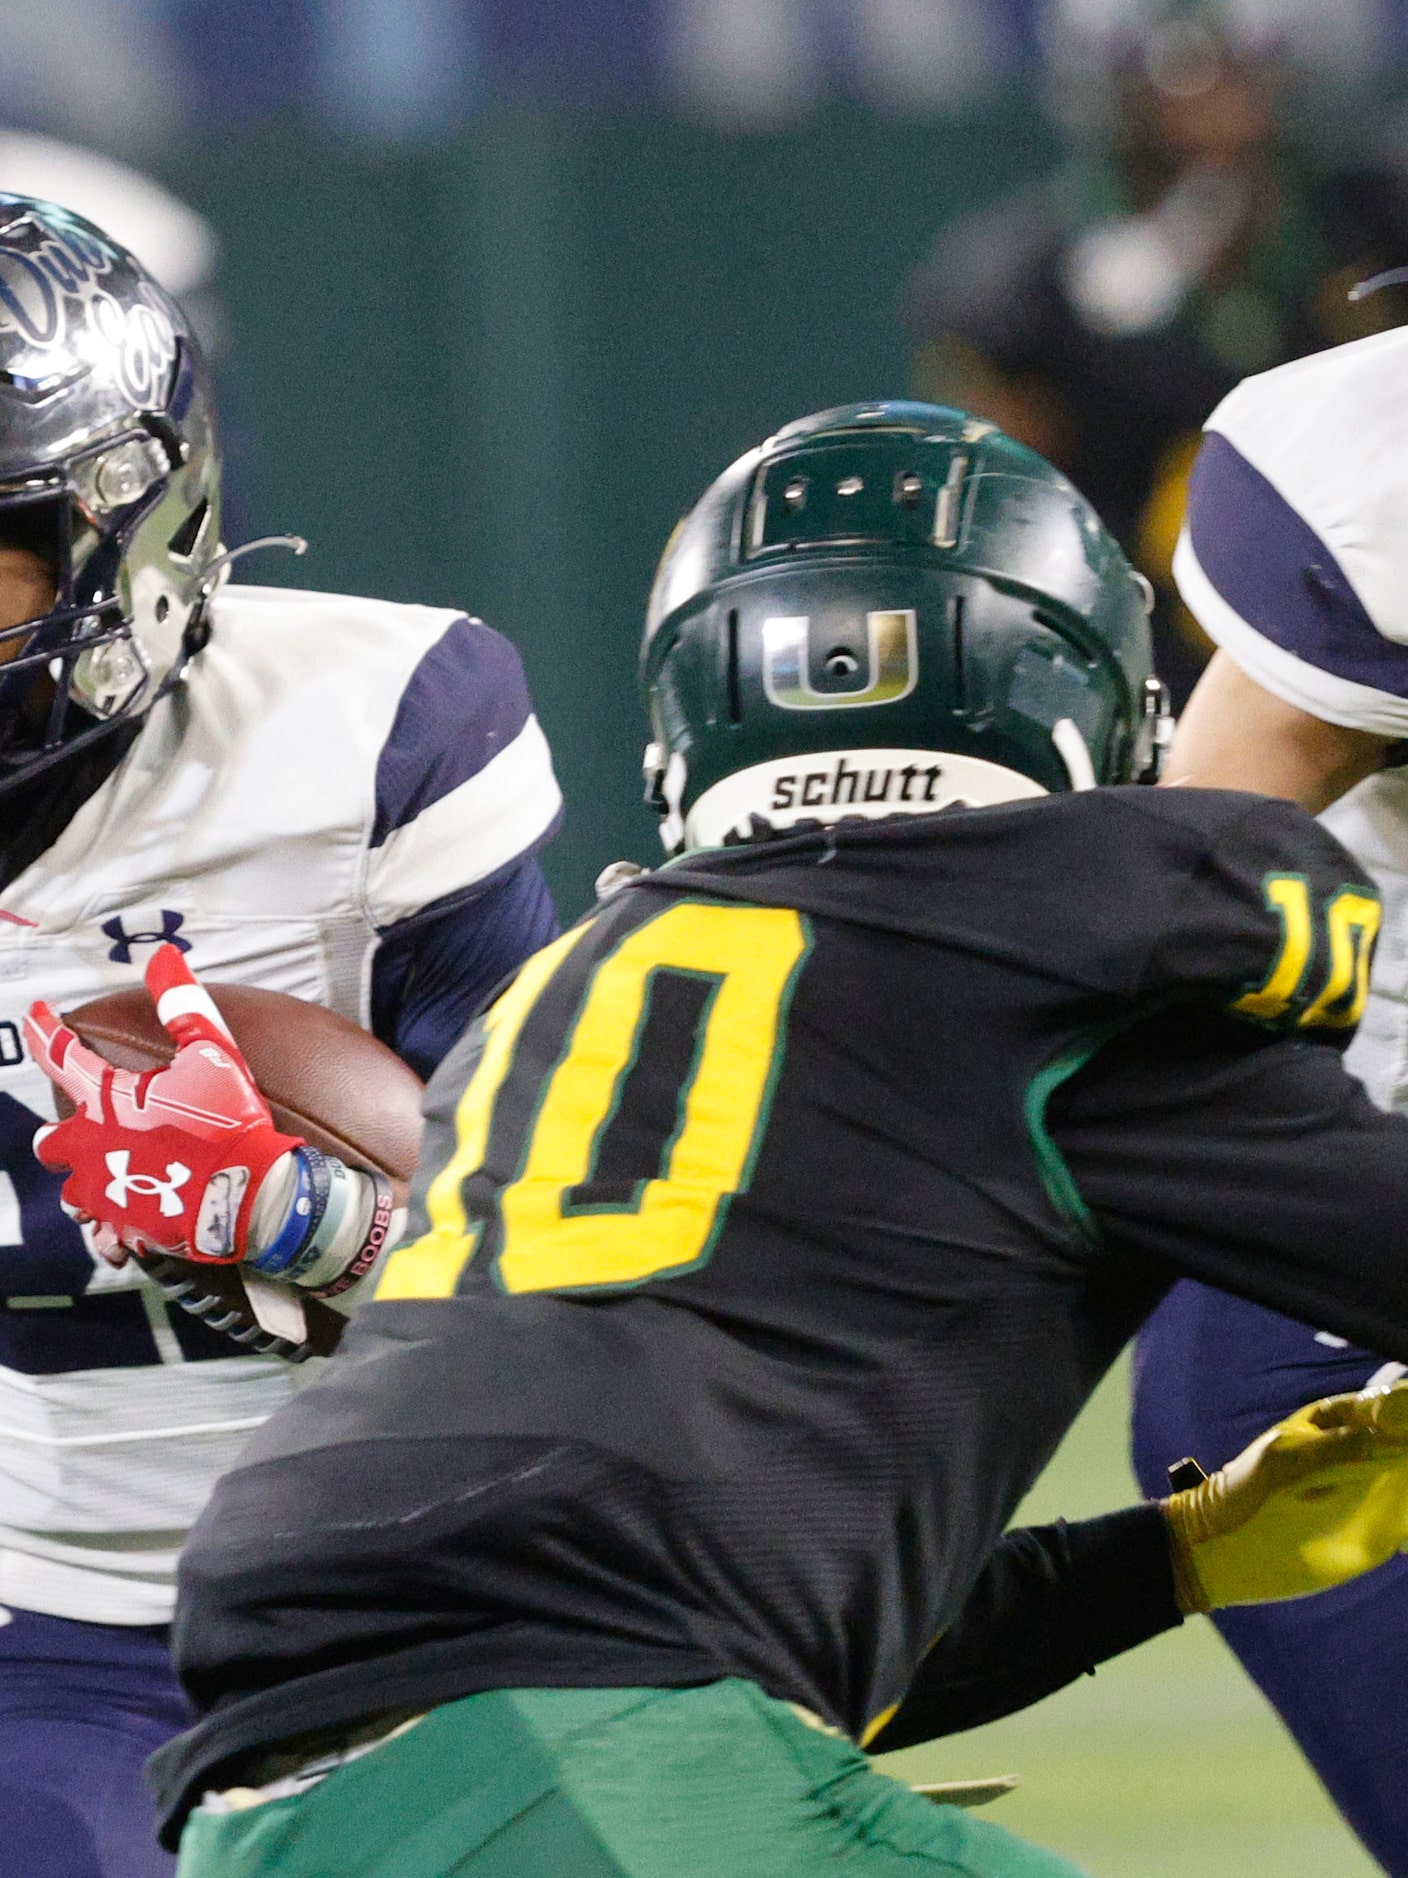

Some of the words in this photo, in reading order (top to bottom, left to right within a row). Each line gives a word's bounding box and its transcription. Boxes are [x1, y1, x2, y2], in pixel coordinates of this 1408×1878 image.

[763, 609, 919, 710] U
[770, 758, 943, 810] schutt
[1230, 871, 1382, 1027] 10
[374, 898, 815, 1299] 10
[350, 1194, 393, 1276] BOOBS
